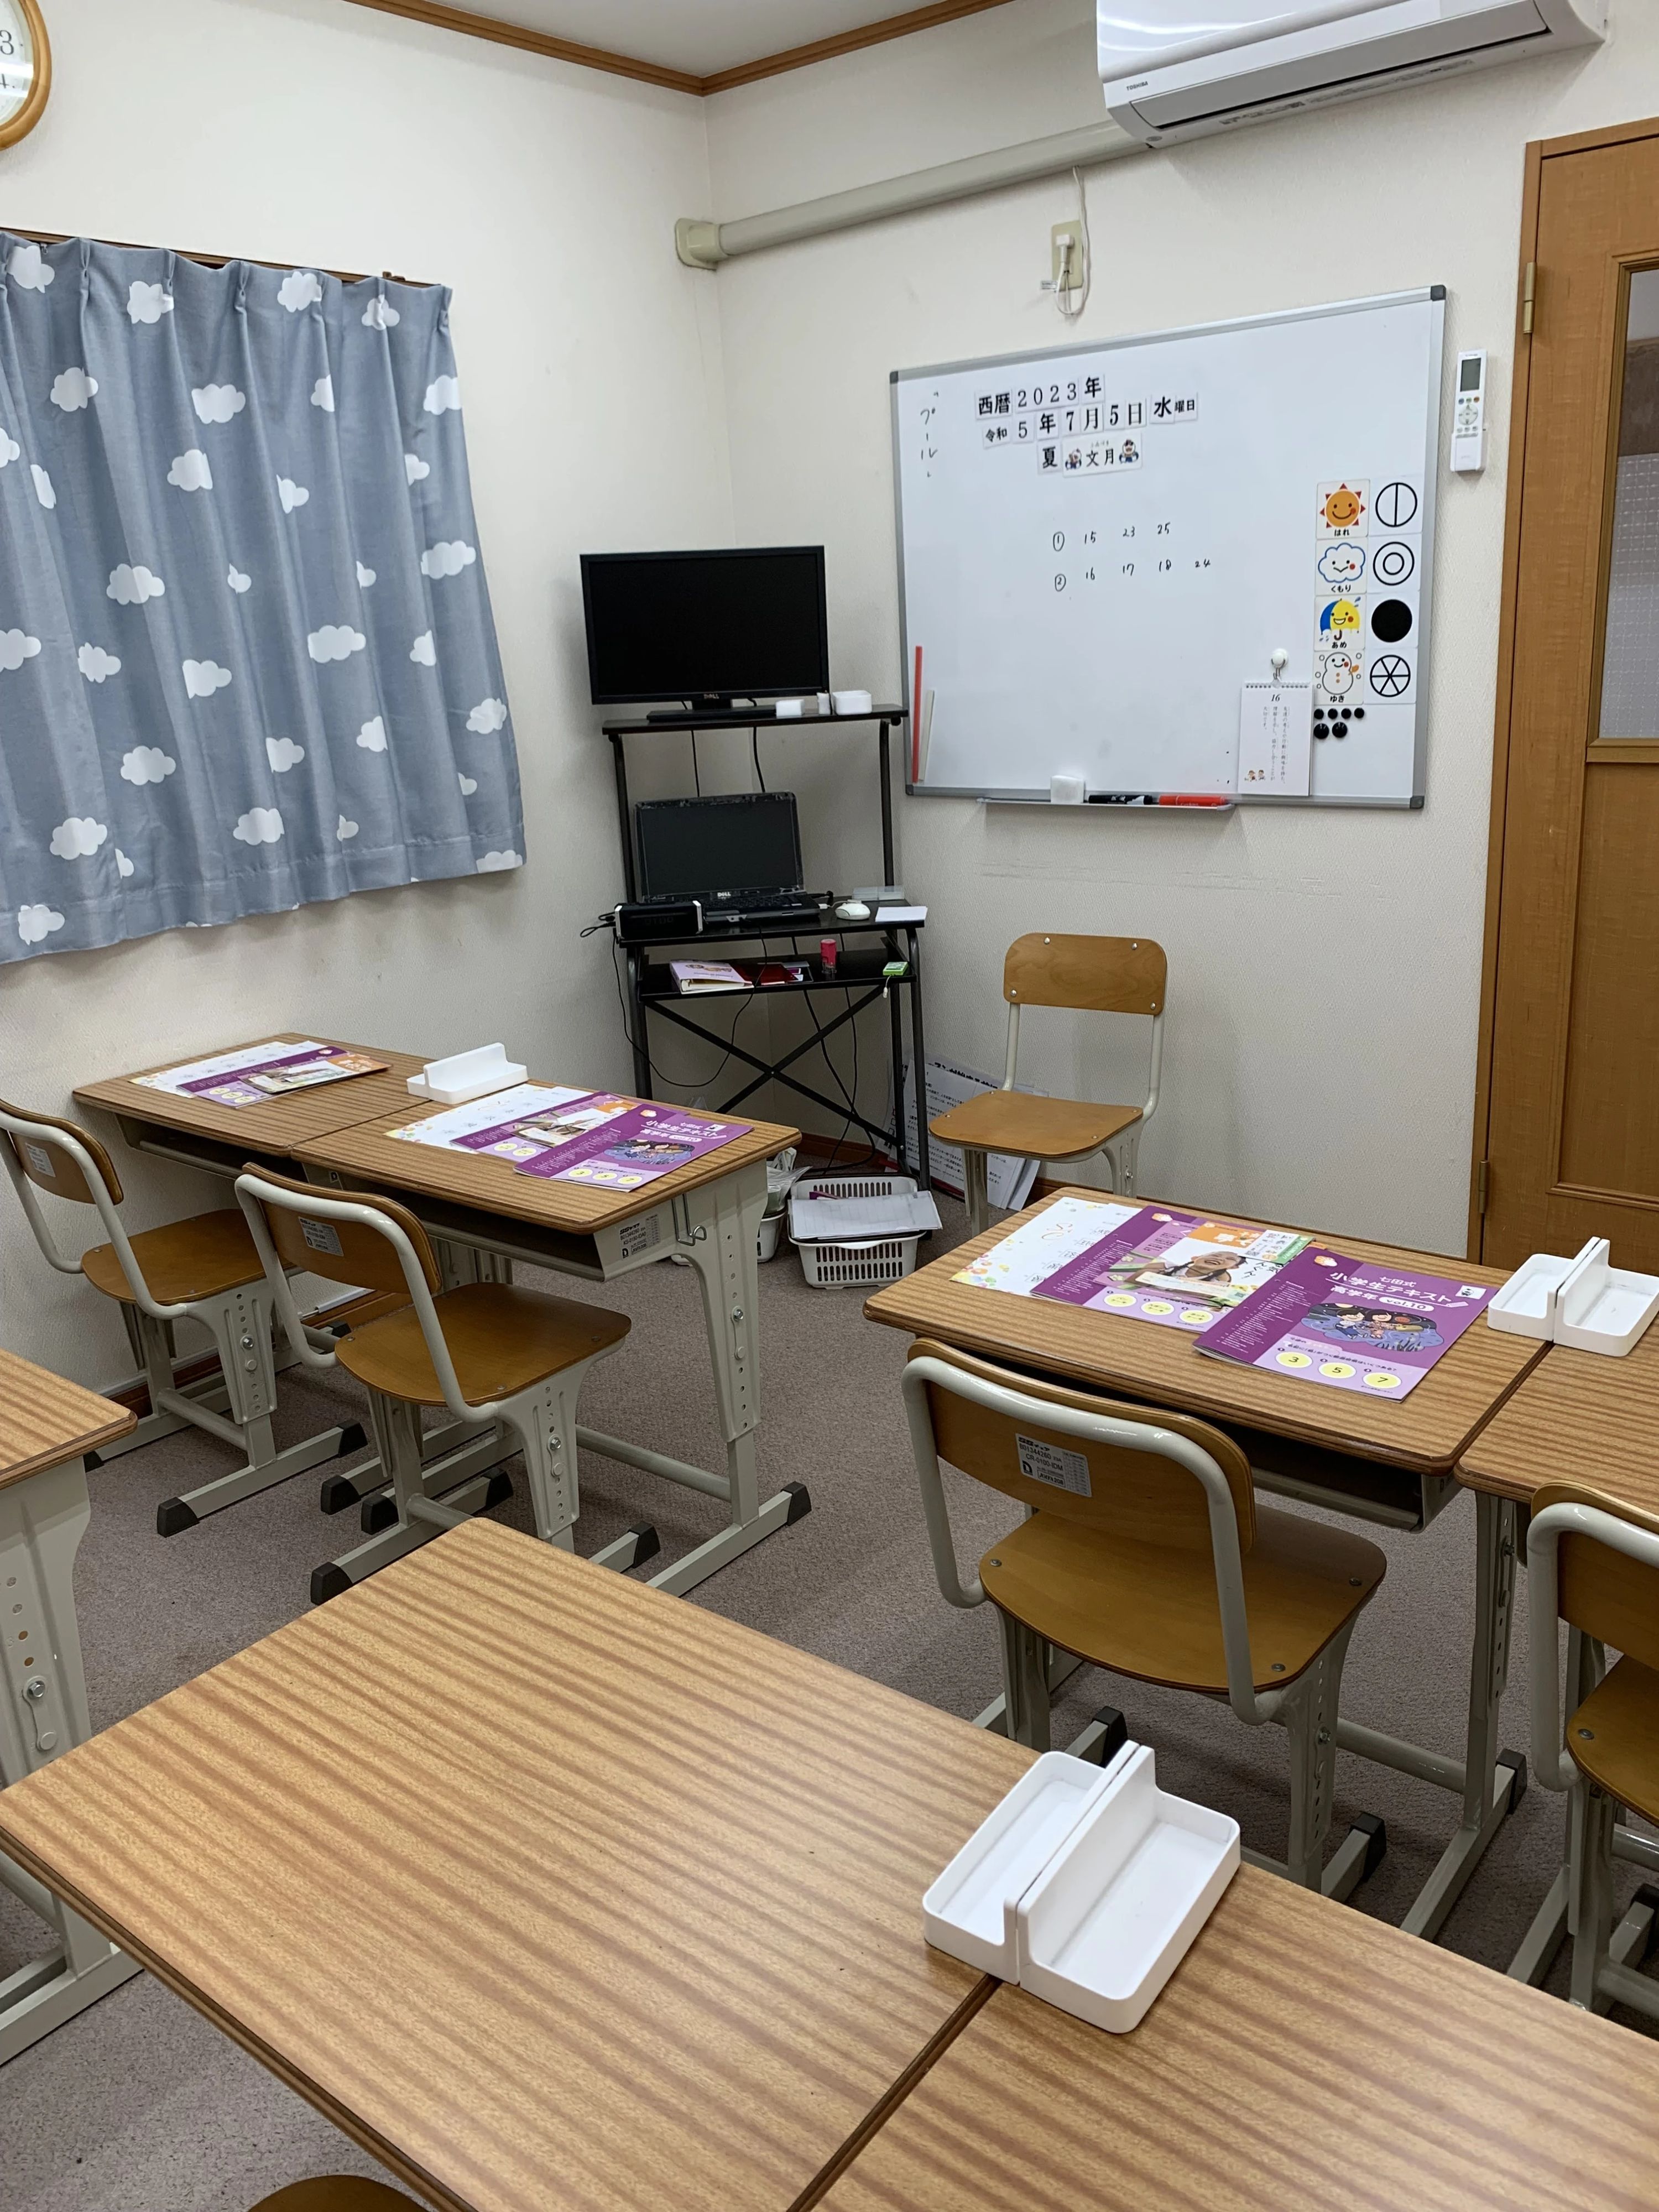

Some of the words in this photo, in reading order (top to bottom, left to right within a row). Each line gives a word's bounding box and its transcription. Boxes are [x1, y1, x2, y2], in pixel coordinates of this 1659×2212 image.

[0, 30, 14, 55] 3
[1126, 81, 1148, 91] TOSHIBA
[1042, 446, 1058, 468] 夏
[1086, 448, 1114, 467] 文月
[1084, 531, 1097, 544] 15
[1123, 526, 1135, 537] 23
[1157, 522, 1171, 534] 25
[1086, 567, 1095, 580] 16
[1123, 563, 1135, 576] 17
[1159, 559, 1171, 572] 18
[1195, 559, 1211, 568] 24
[1331, 585, 1351, 593] くもり
[646, 1120, 718, 1136] 小学生テキスト
[1330, 1272, 1452, 1303] 小学生テキスト
[1380, 1276, 1417, 1287] 七田式
[1331, 1285, 1379, 1301] 高学年
[1386, 1299, 1426, 1310] vol.10
